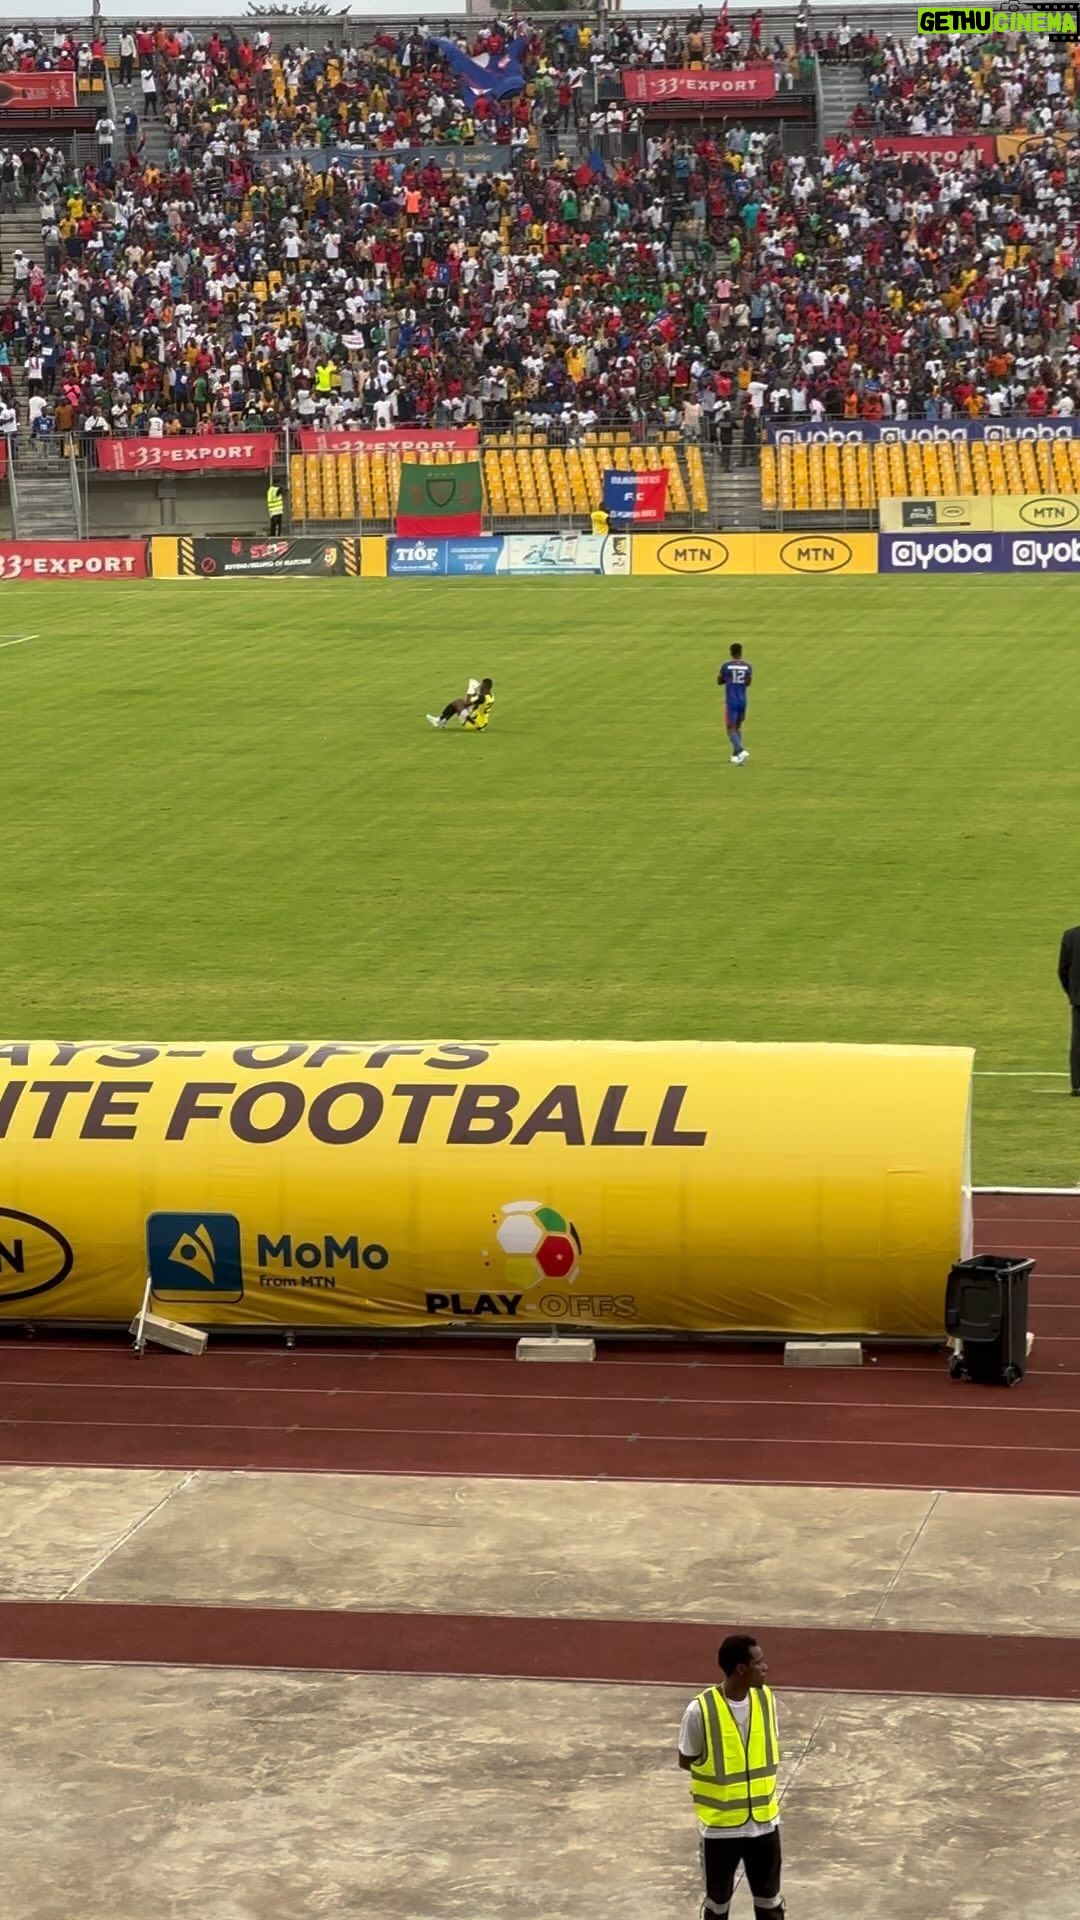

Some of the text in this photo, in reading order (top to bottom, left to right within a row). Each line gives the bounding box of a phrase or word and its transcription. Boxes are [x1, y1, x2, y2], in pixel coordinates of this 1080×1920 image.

[686, 79, 757, 91] EXPORT
[902, 149, 984, 163] EXPOT
[171, 445, 254, 461] EXPORT
[1033, 507, 1065, 518] MTN
[396, 548, 438, 560] TIOF
[674, 548, 711, 561] MTN
[797, 547, 834, 561] MTN
[33, 556, 136, 573] EXPORT
[732, 669, 746, 684] 12
[233, 1043, 500, 1070] OFFS
[164, 1081, 708, 1146] FOOTBALL
[257, 1234, 389, 1270] MoMo
[260, 1274, 336, 1288] from MTN
